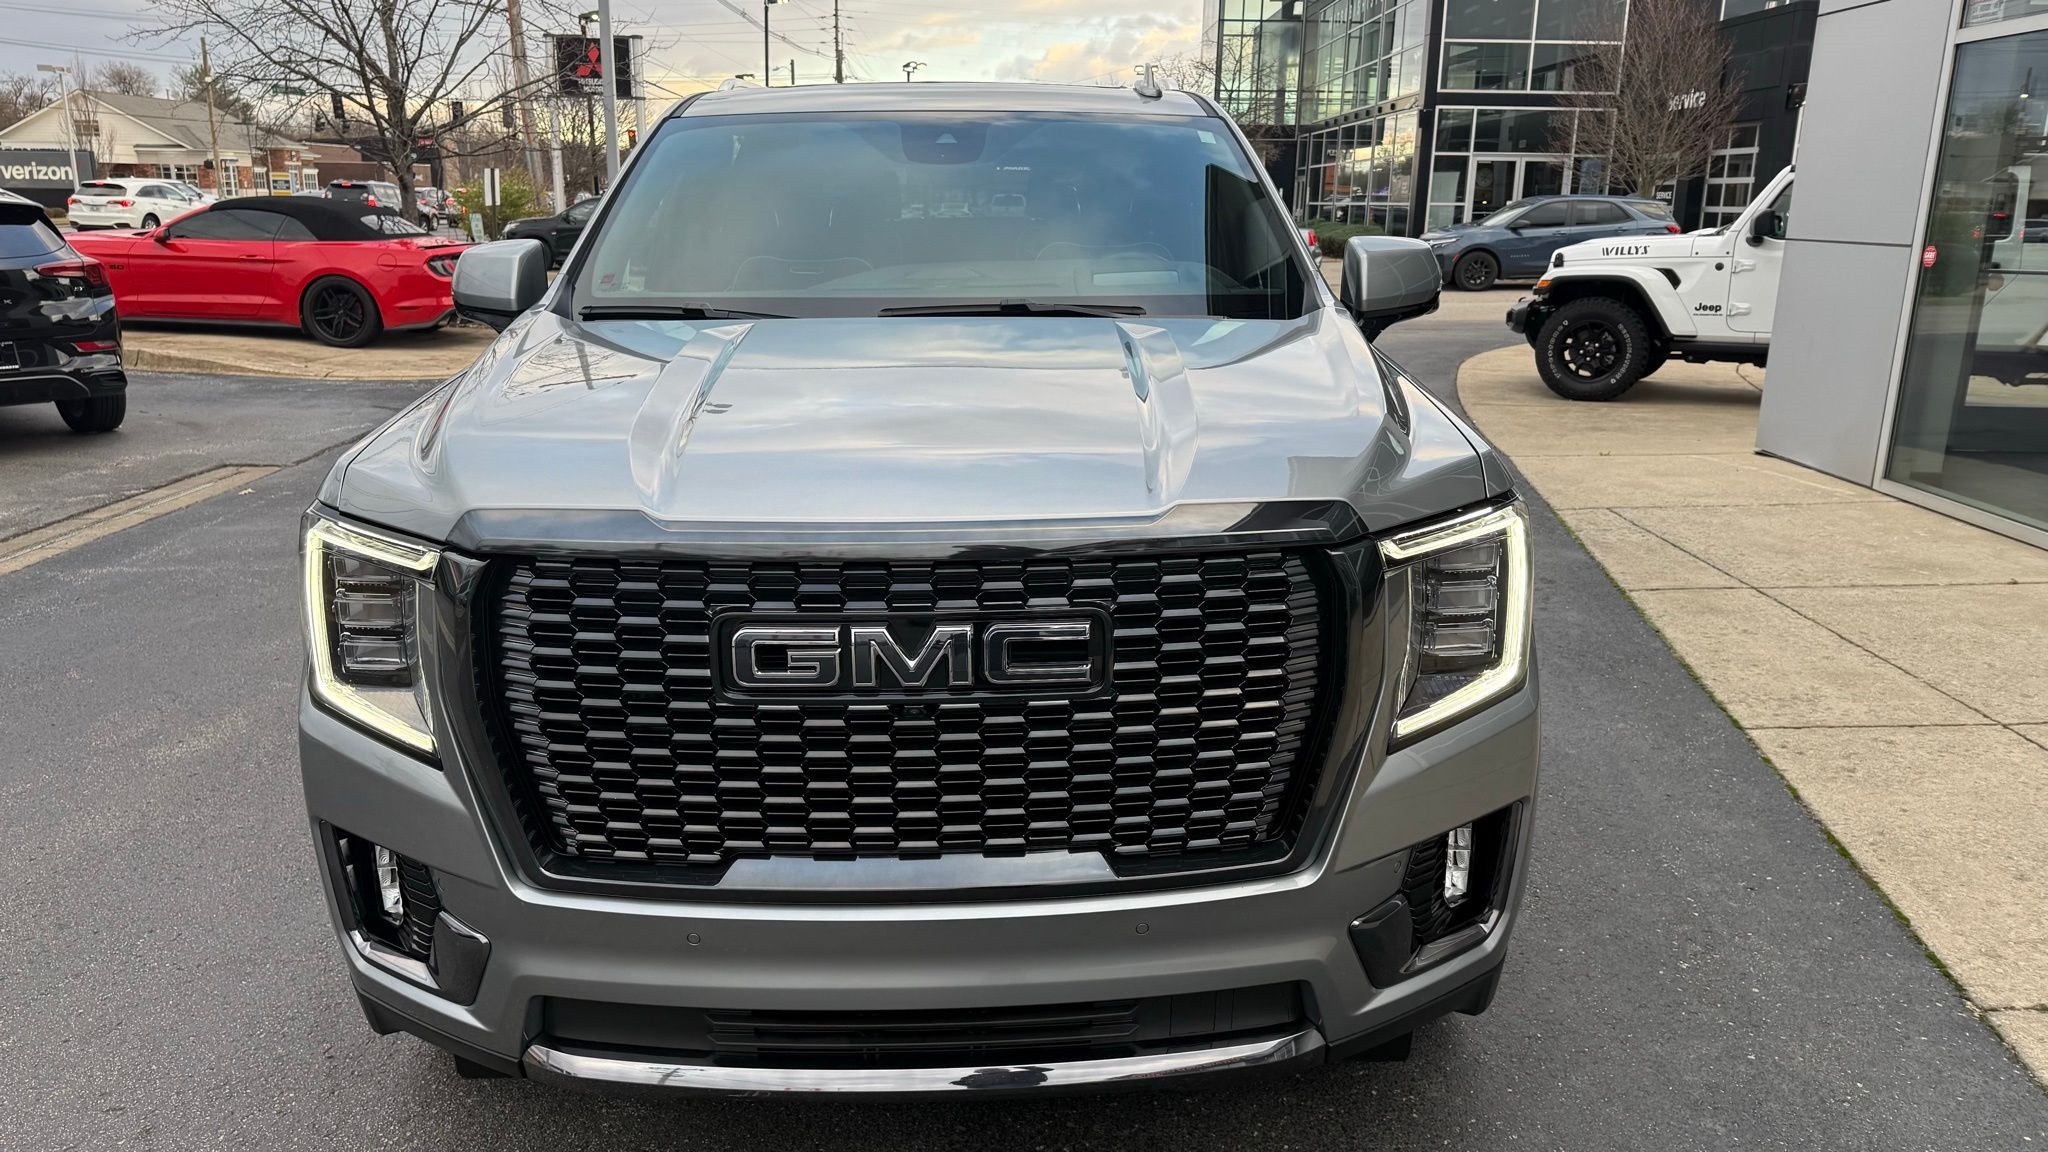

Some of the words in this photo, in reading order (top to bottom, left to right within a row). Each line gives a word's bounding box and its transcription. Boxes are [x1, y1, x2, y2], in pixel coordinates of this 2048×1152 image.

[0, 161, 74, 180] verizon
[1656, 191, 1672, 199] SERVICE
[1602, 245, 1650, 256] WILLYS
[1694, 302, 1722, 312] Jeep
[731, 621, 1093, 688] GMC
